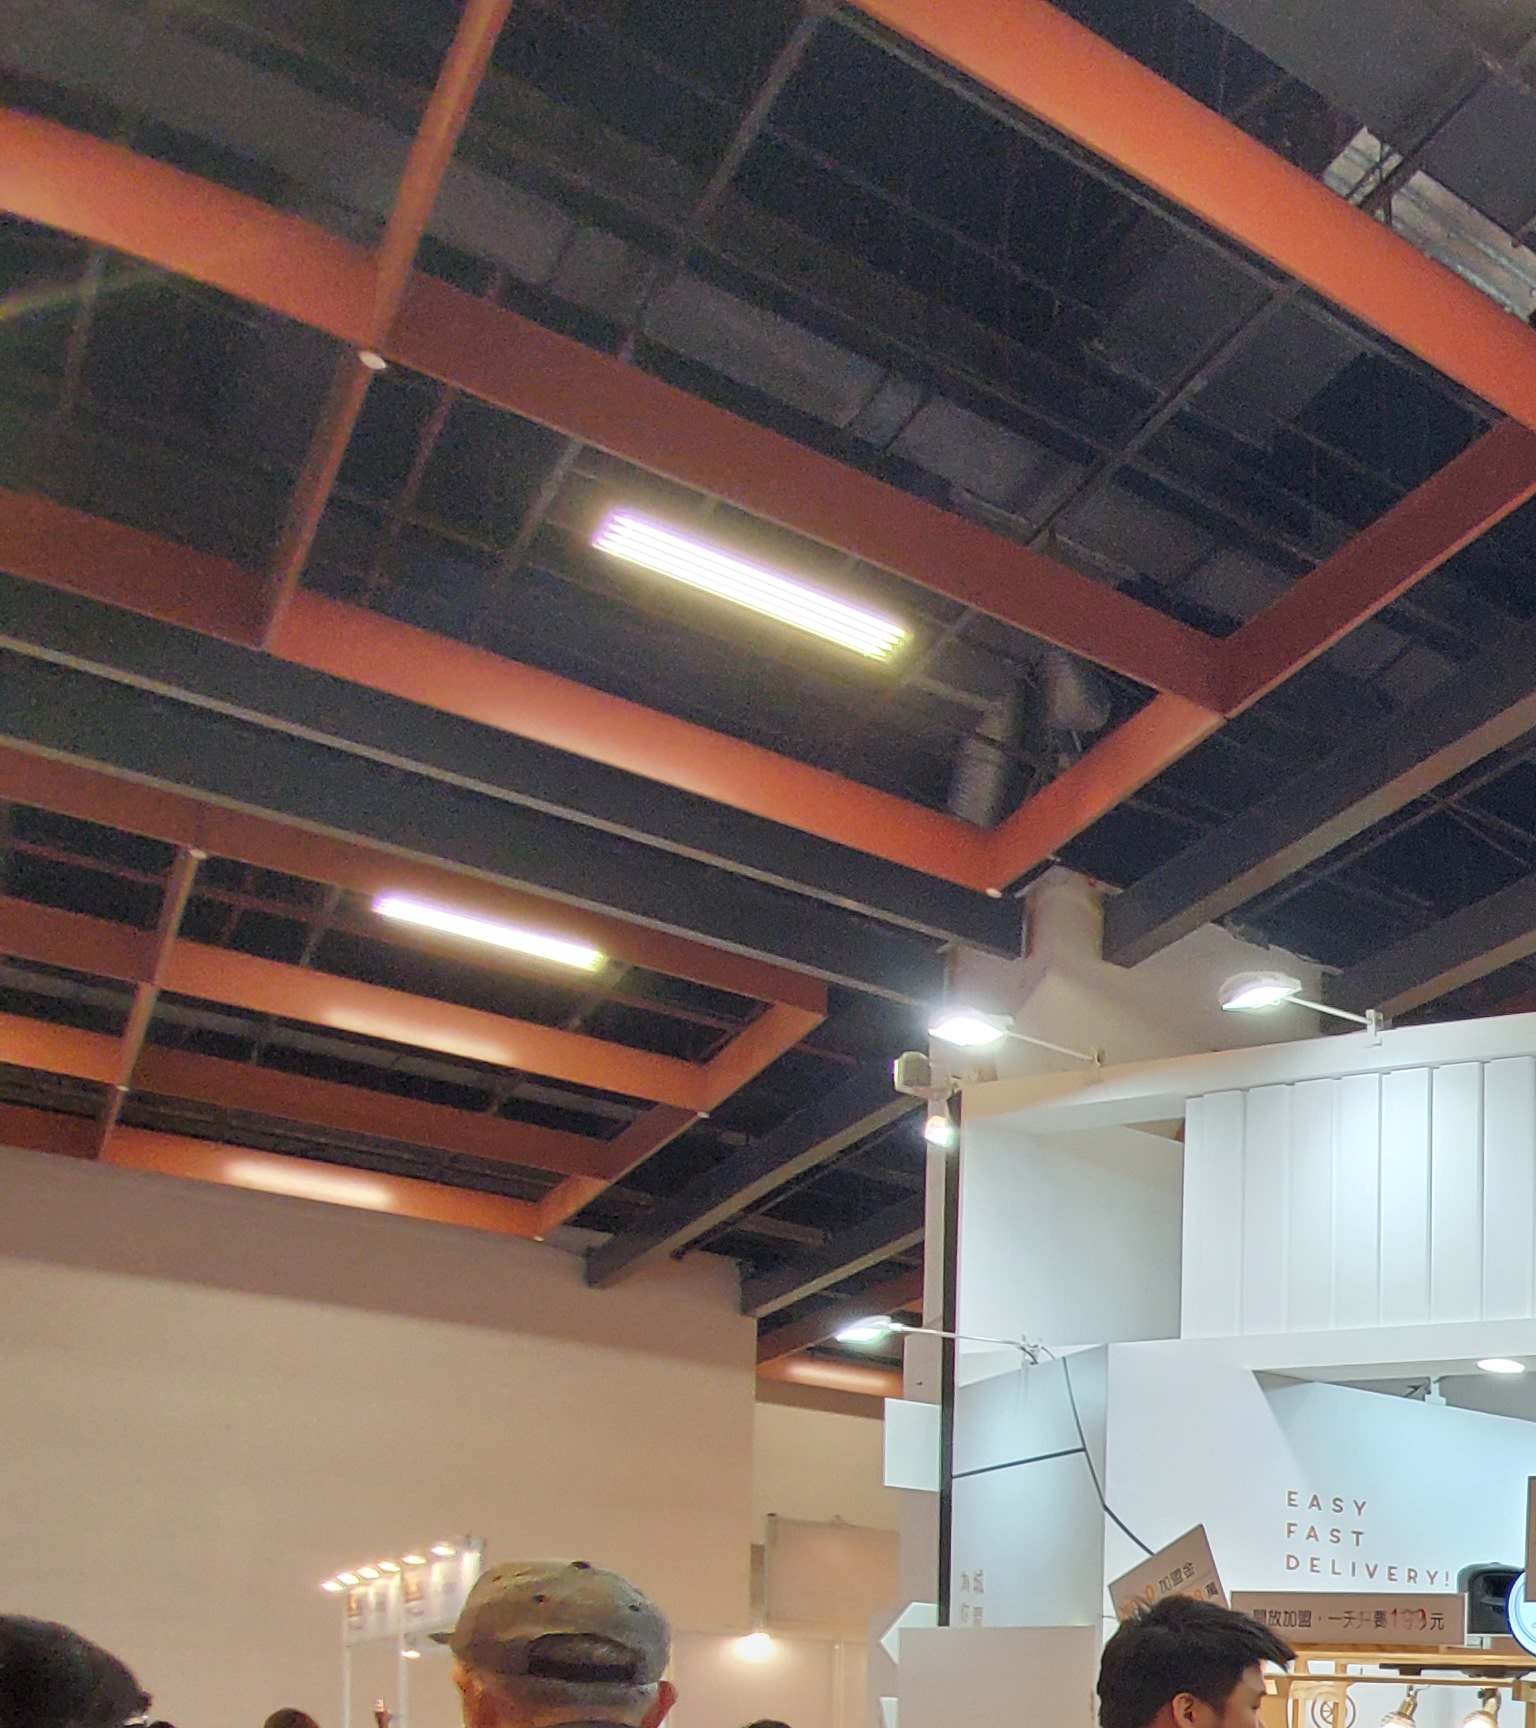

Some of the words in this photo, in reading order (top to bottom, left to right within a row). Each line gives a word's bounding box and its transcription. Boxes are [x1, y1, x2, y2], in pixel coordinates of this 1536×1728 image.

[1286, 1490, 1369, 1517] EASY
[1286, 1522, 1366, 1548] FAST
[1285, 1552, 1452, 1588] DELIVERY!
